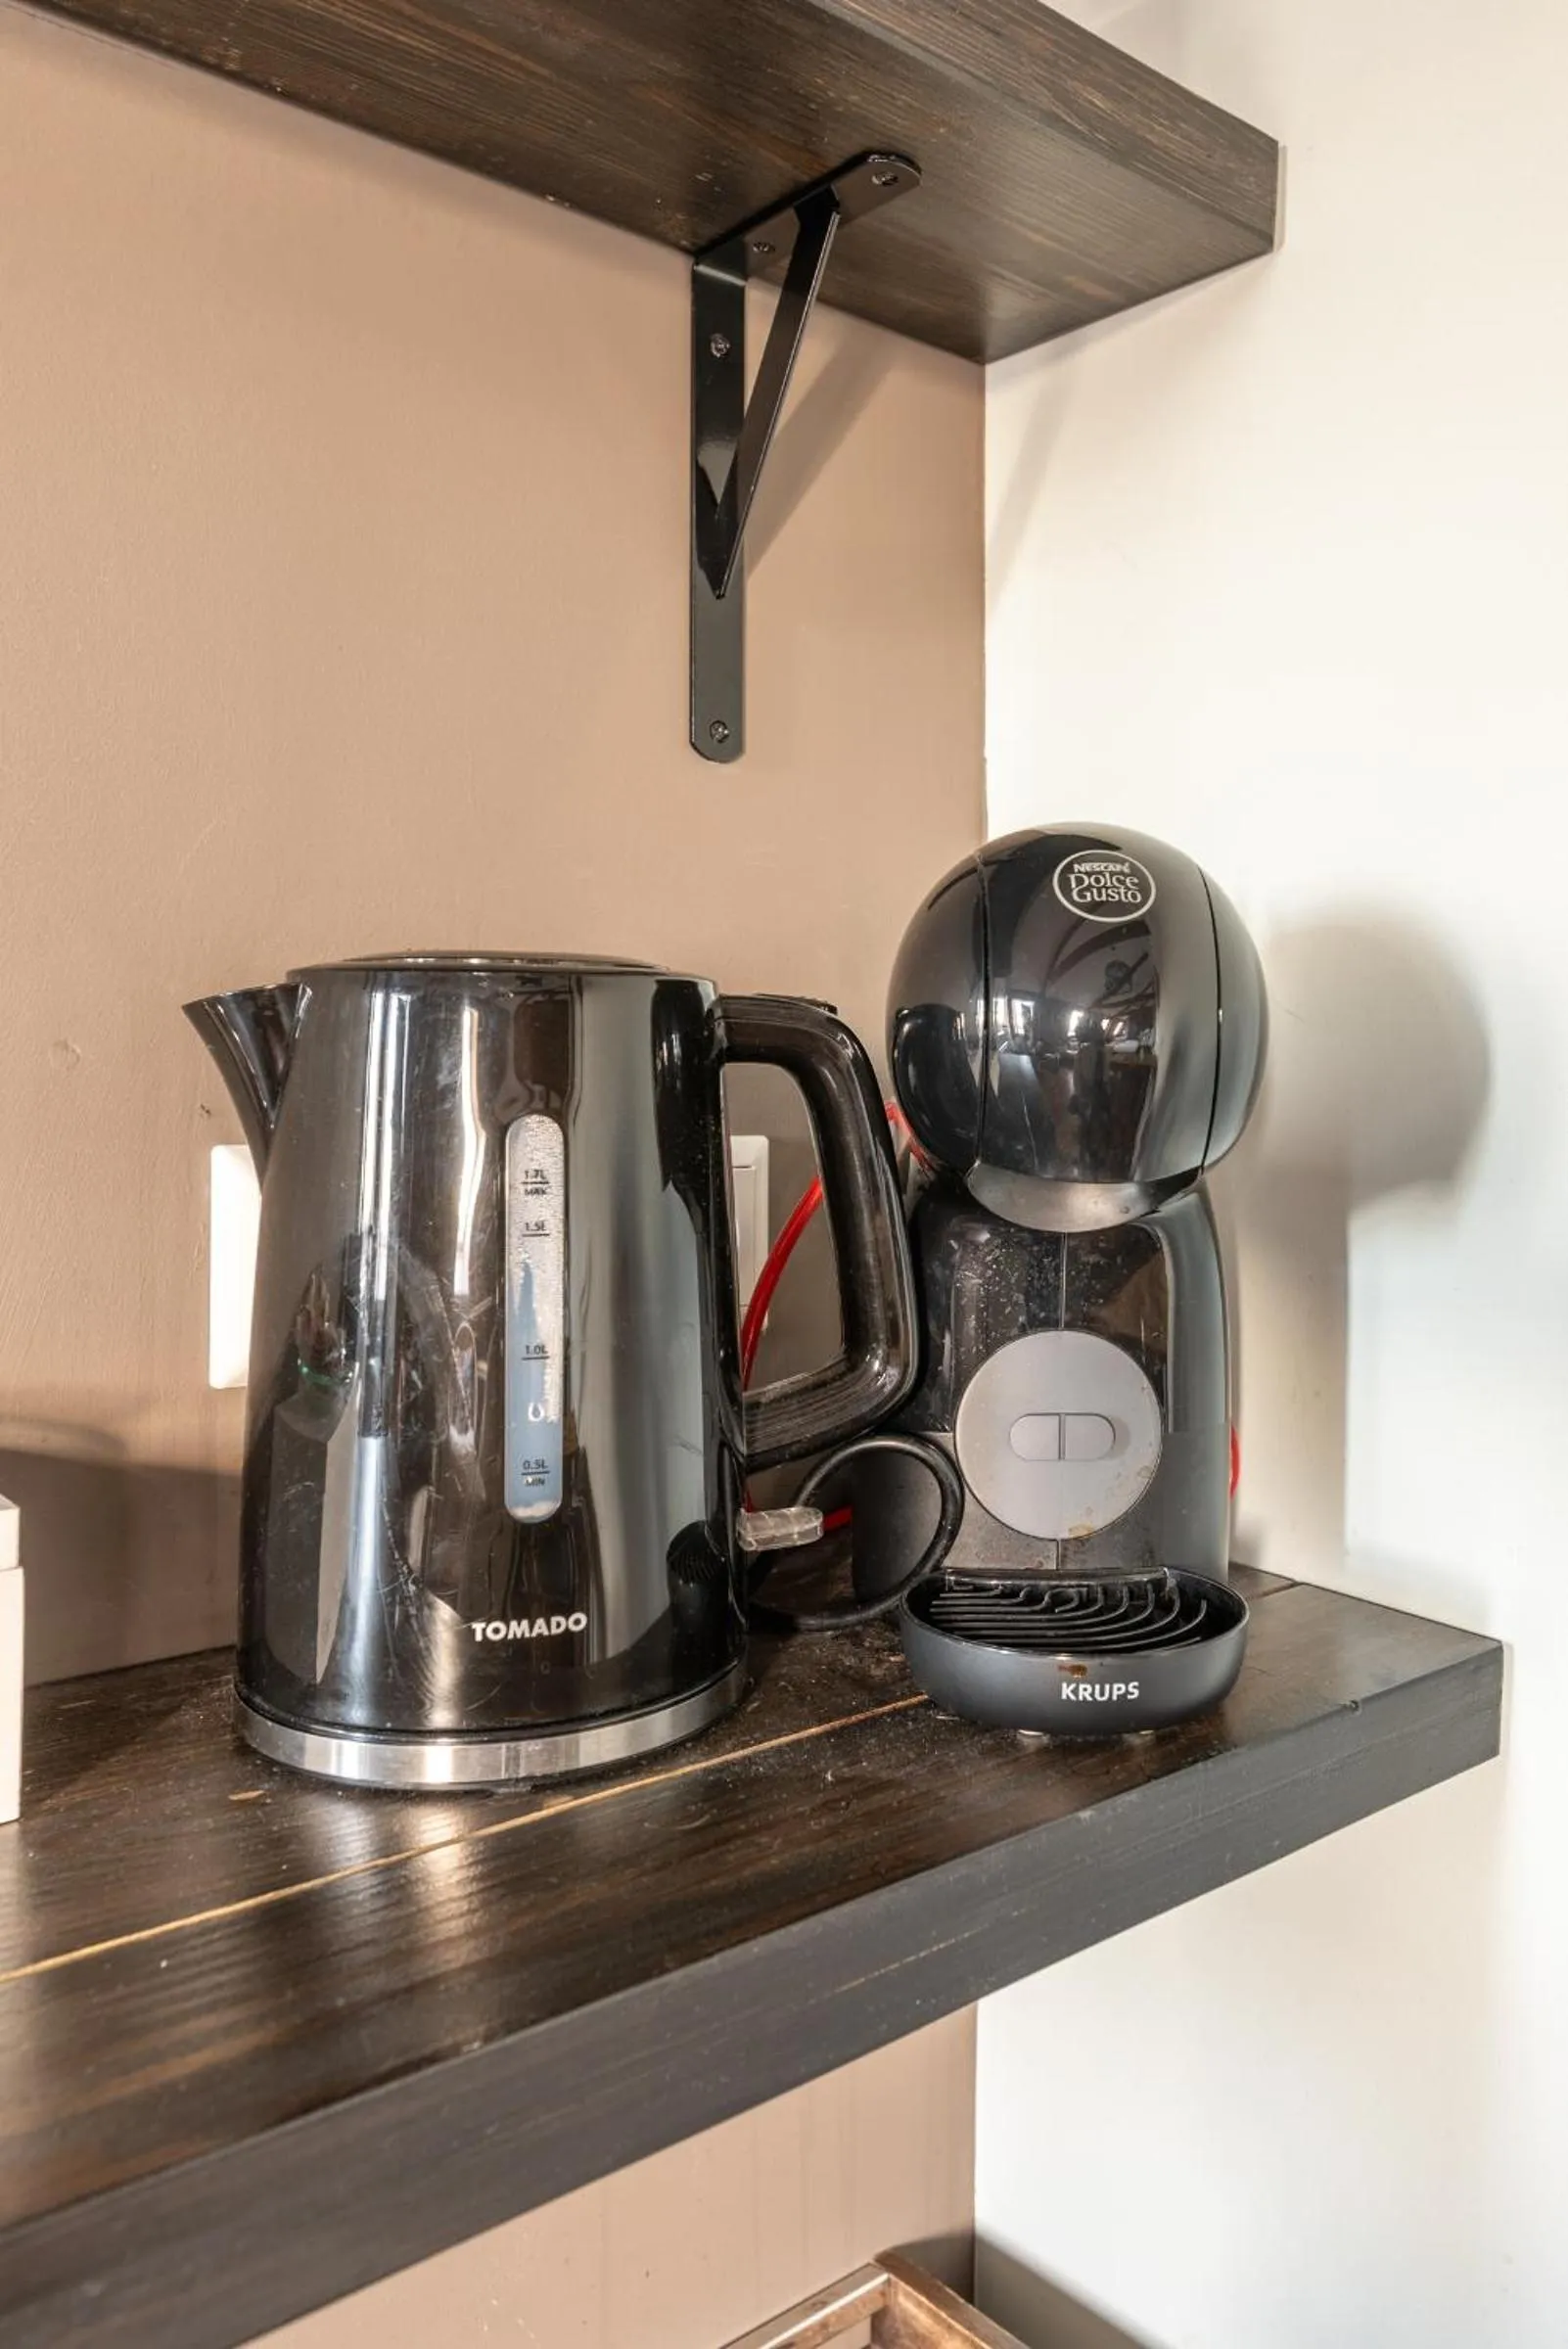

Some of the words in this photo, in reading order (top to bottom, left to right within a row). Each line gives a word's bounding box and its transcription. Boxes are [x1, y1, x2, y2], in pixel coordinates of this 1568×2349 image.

[1068, 871, 1139, 889] Dolce
[1072, 886, 1142, 903] Gusto
[525, 1345, 548, 1356] 1.0L
[523, 1459, 548, 1470] 0.5L
[471, 1612, 587, 1642] TOMADO
[1061, 1681, 1140, 1701] KRUPS
